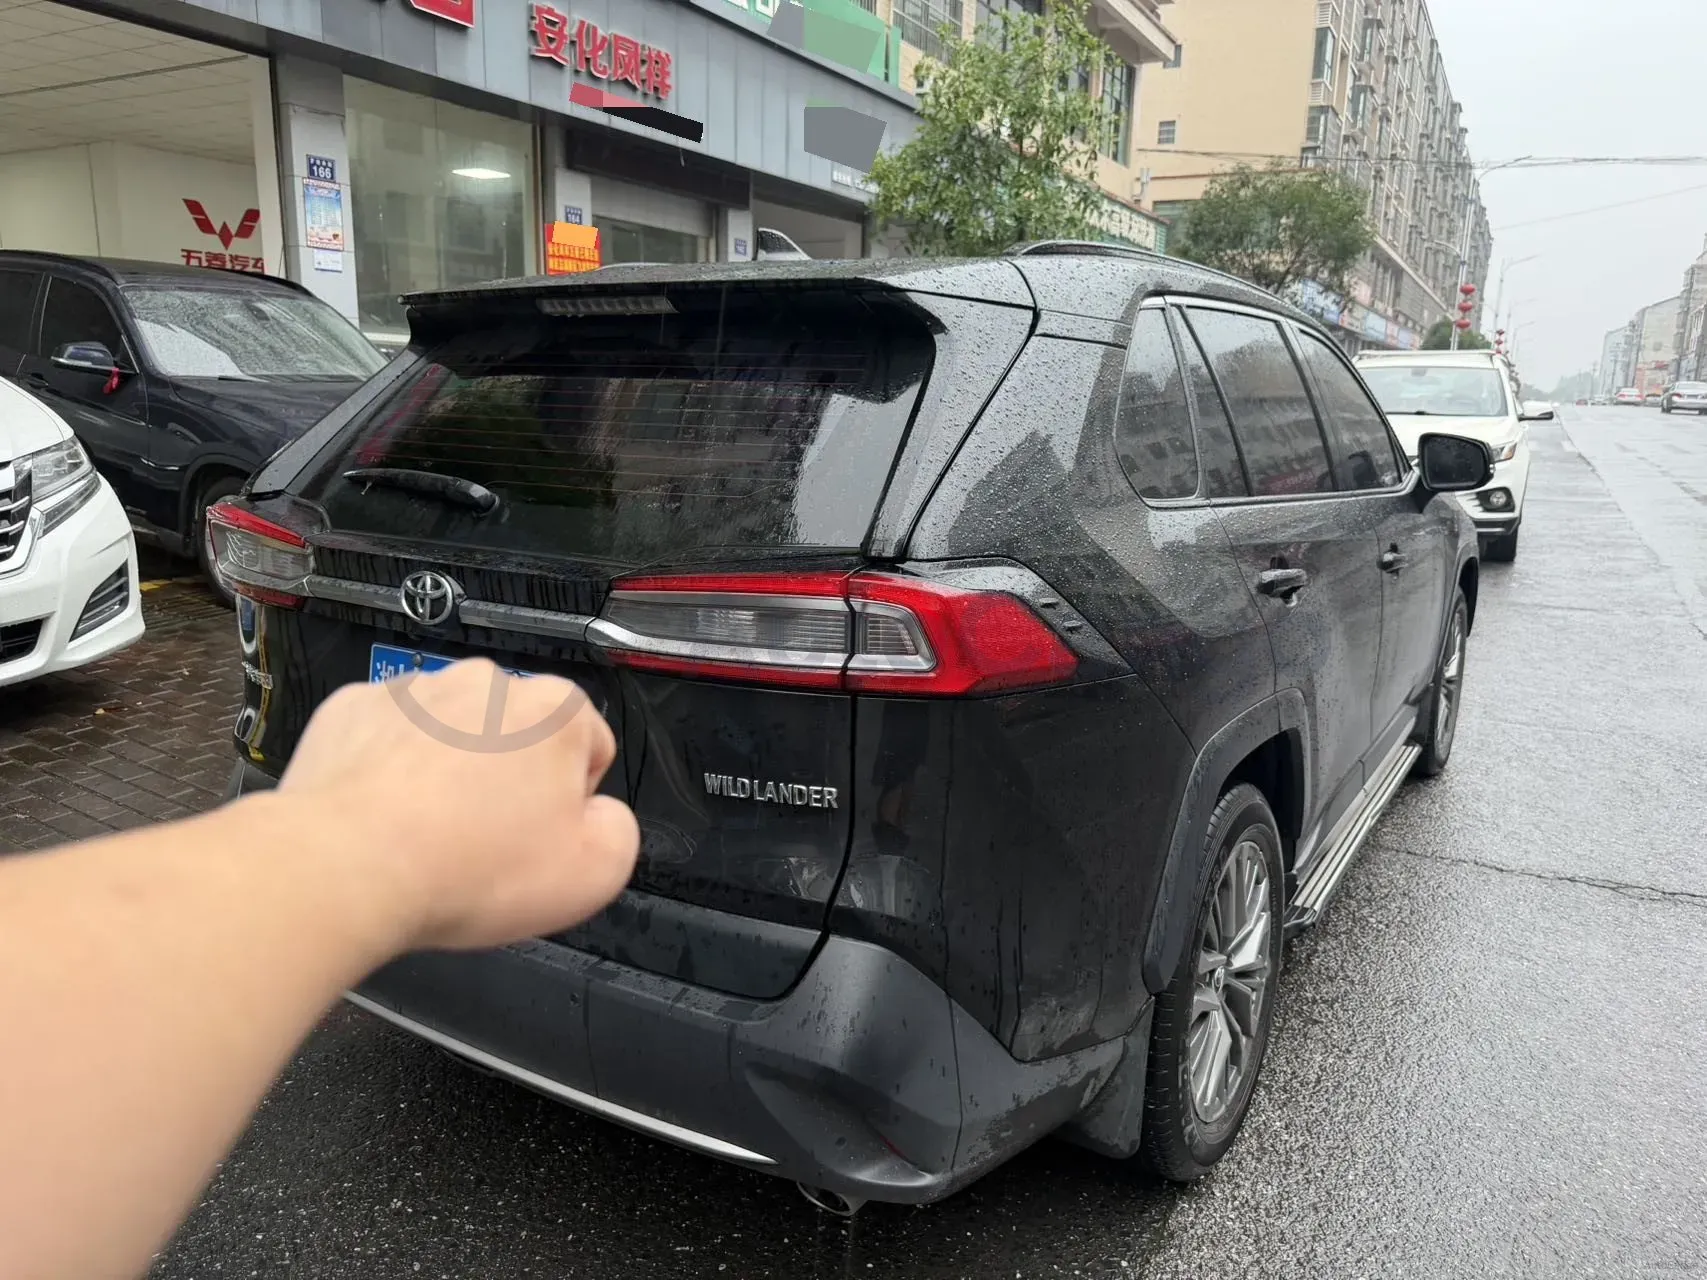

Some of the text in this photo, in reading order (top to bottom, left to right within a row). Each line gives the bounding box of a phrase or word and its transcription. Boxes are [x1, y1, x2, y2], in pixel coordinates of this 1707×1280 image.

[529, 3, 673, 99] 安化凤祥
[312, 165, 332, 179] 166
